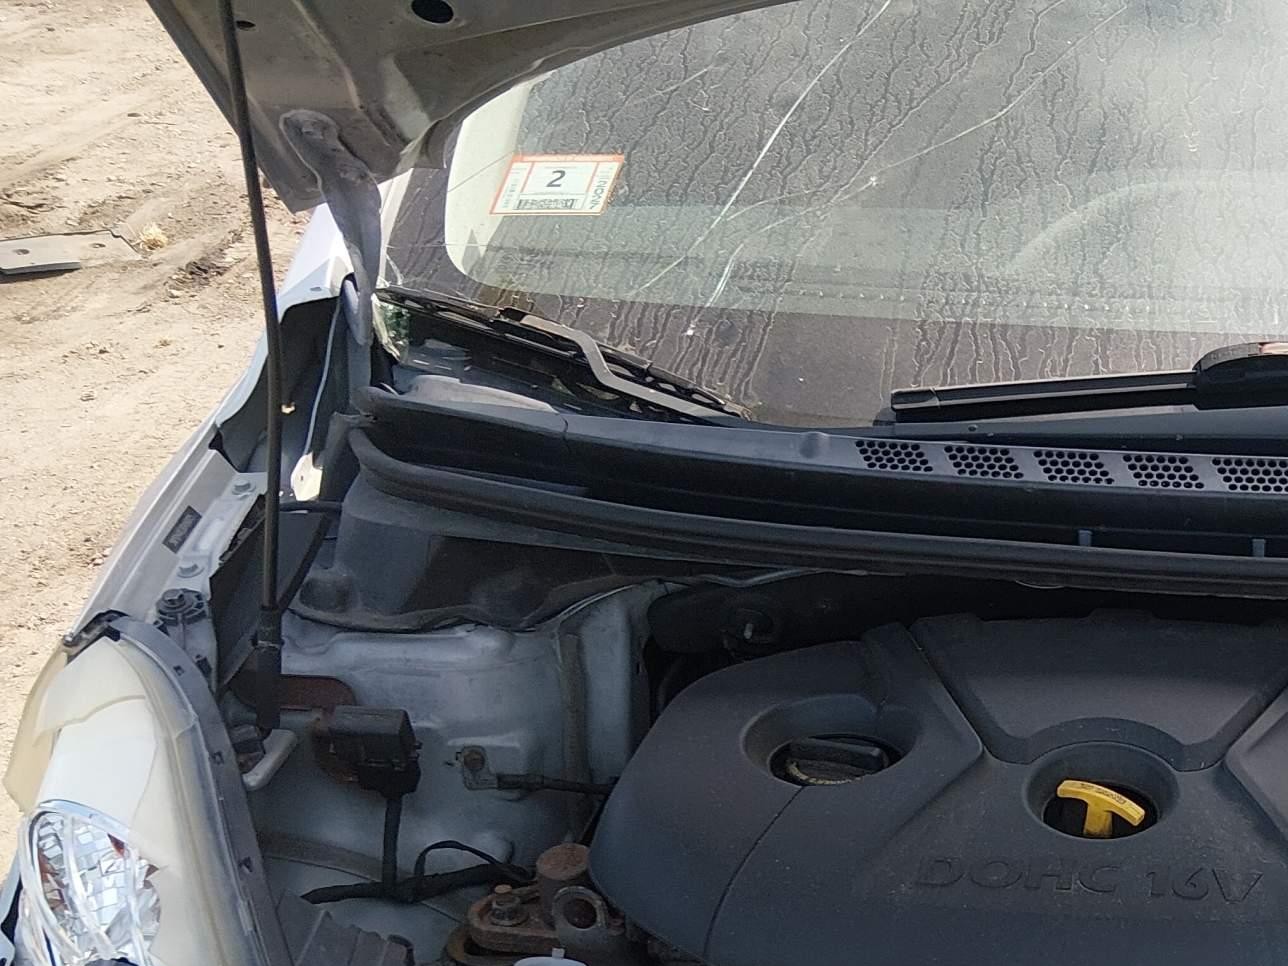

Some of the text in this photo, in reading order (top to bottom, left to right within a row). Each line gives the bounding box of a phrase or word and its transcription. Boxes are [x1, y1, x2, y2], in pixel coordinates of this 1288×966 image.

[545, 168, 567, 188] 2
[915, 857, 1265, 905] DOHC 16V
